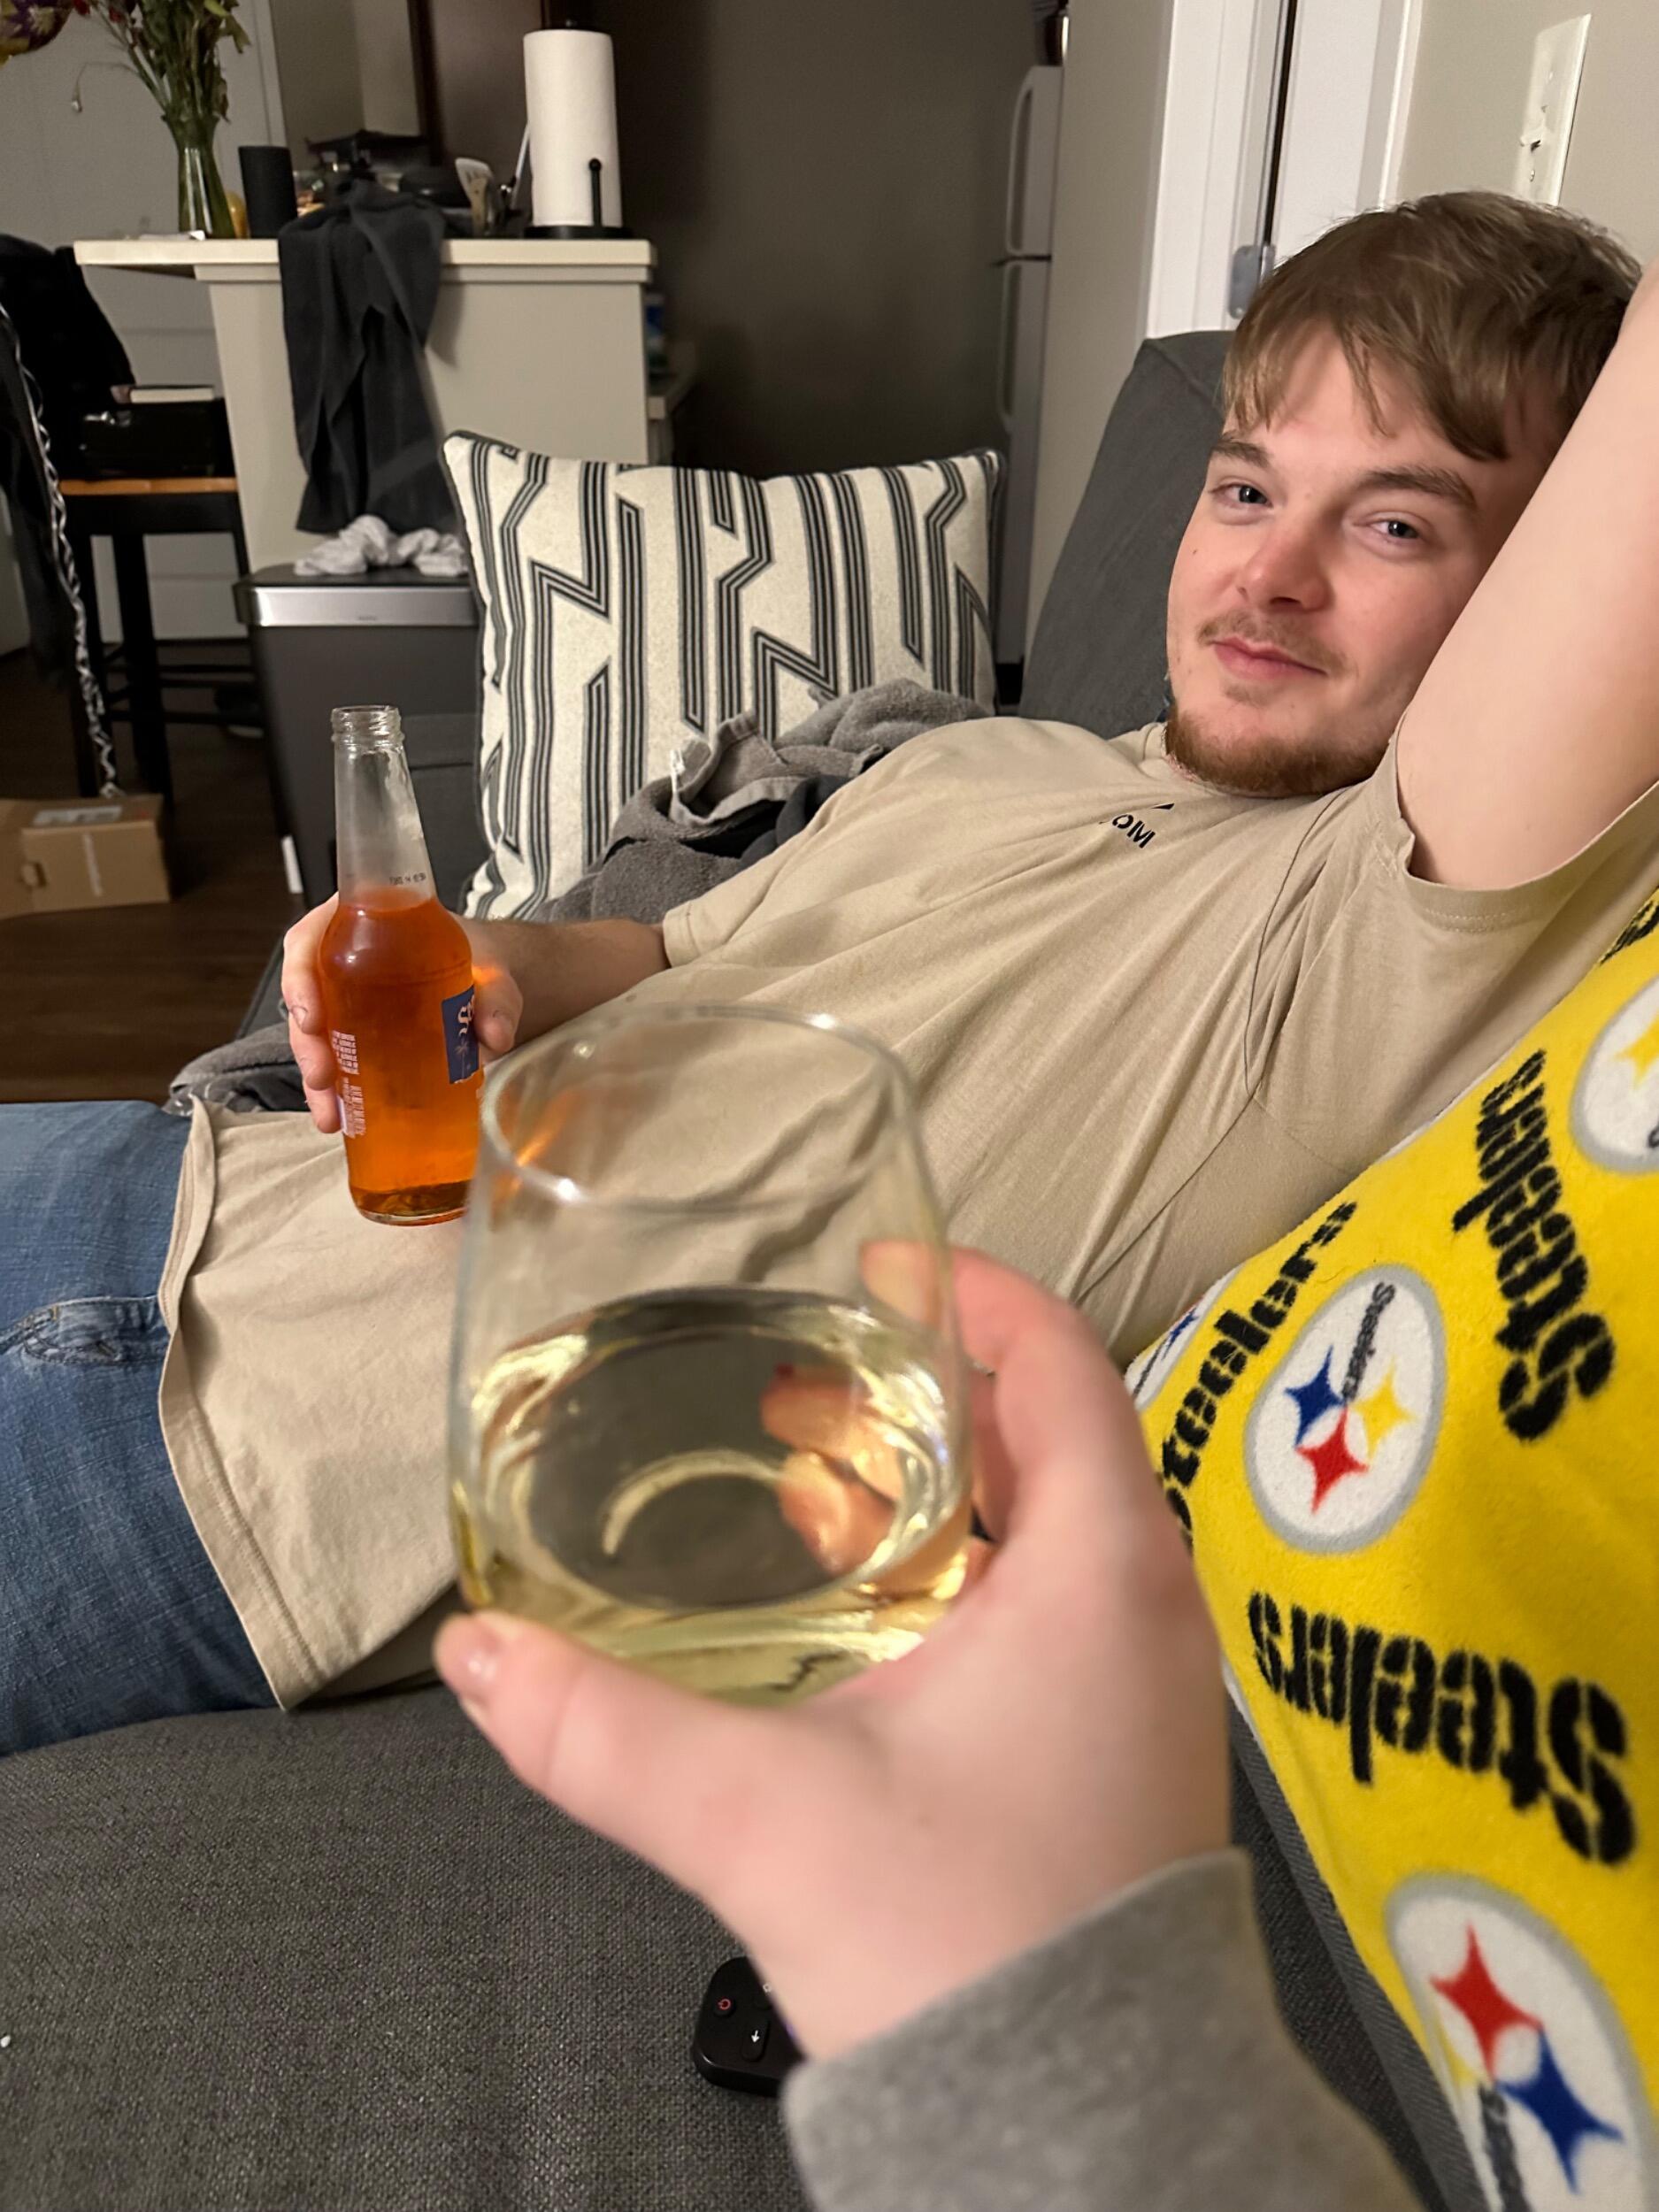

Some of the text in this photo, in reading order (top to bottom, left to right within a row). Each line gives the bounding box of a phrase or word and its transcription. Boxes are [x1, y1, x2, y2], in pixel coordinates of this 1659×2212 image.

[1099, 814, 1156, 849] OM
[1453, 1050, 1614, 1441] Steelers
[1248, 1592, 1635, 1866] Steelers
